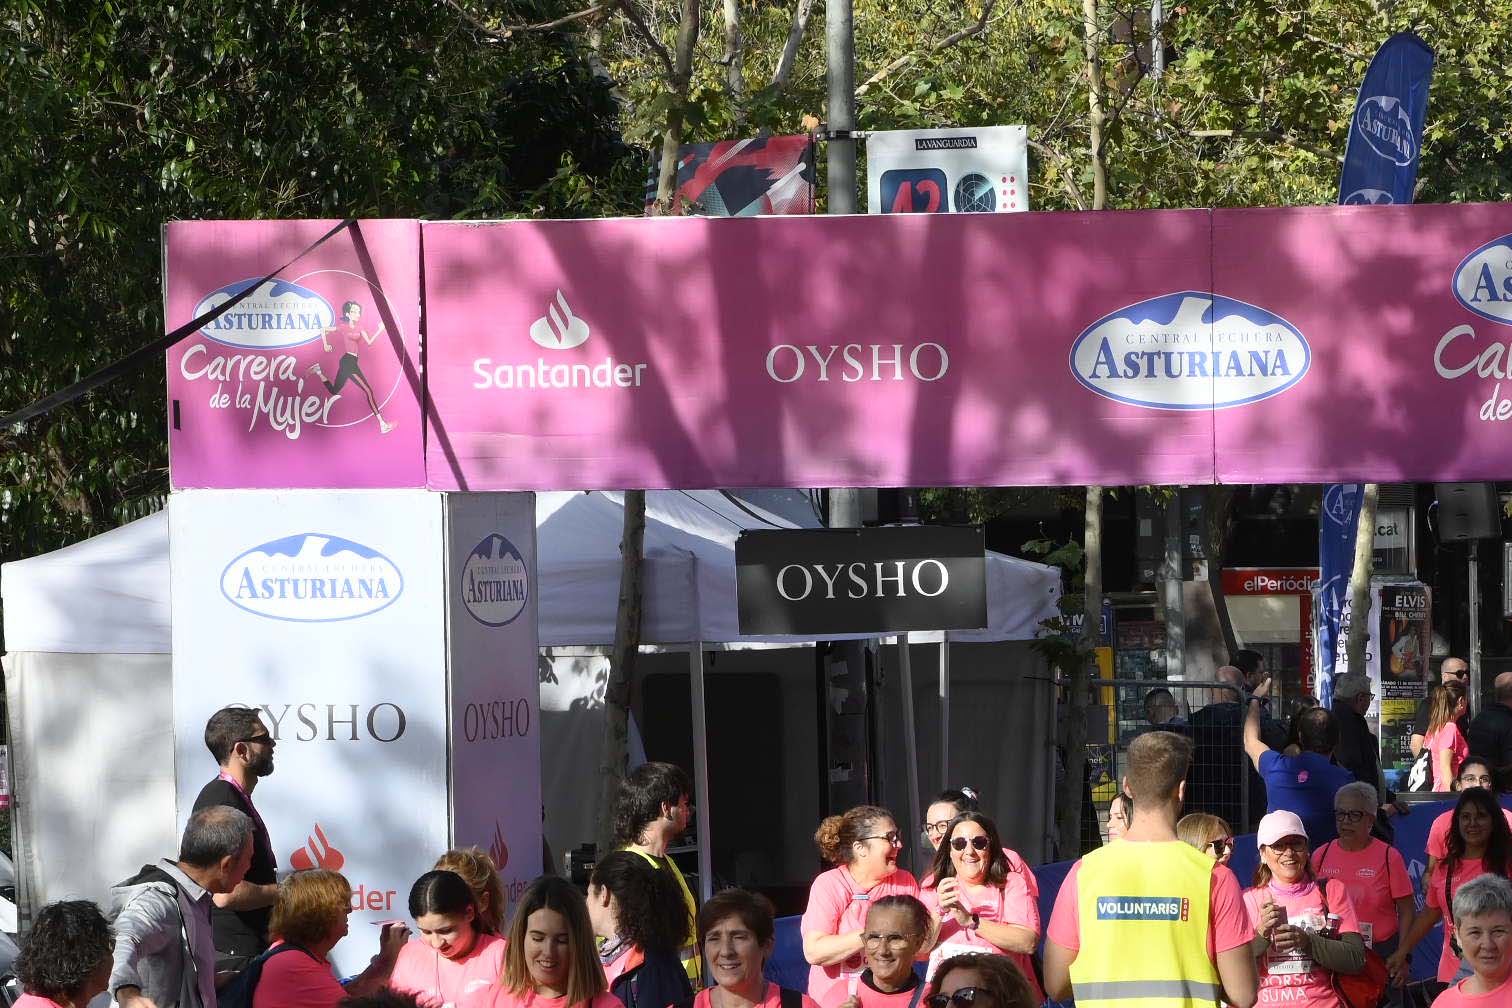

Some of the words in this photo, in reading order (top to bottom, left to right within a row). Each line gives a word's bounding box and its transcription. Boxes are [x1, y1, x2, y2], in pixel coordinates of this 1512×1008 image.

[1126, 332, 1198, 345] CENTRAL
[1209, 331, 1283, 344] LECHERA
[181, 345, 296, 381] Carrera
[473, 357, 648, 389] Santander
[765, 341, 949, 384] OYSHO
[1089, 336, 1293, 380] ASTURIANA
[209, 388, 231, 410] de
[235, 386, 252, 410] la
[249, 380, 341, 440] Mujer
[1480, 382, 1512, 422] de
[235, 566, 390, 600] ASTURIANA
[467, 568, 524, 604] ASTURIANA
[776, 559, 950, 602] OYSHO
[1395, 595, 1426, 608] ELVIS
[223, 701, 407, 742] YSHO
[464, 697, 530, 742] OYSHO
[1098, 902, 1178, 915] VOLUNTARIS
[1262, 988, 1308, 1002] SUMA
